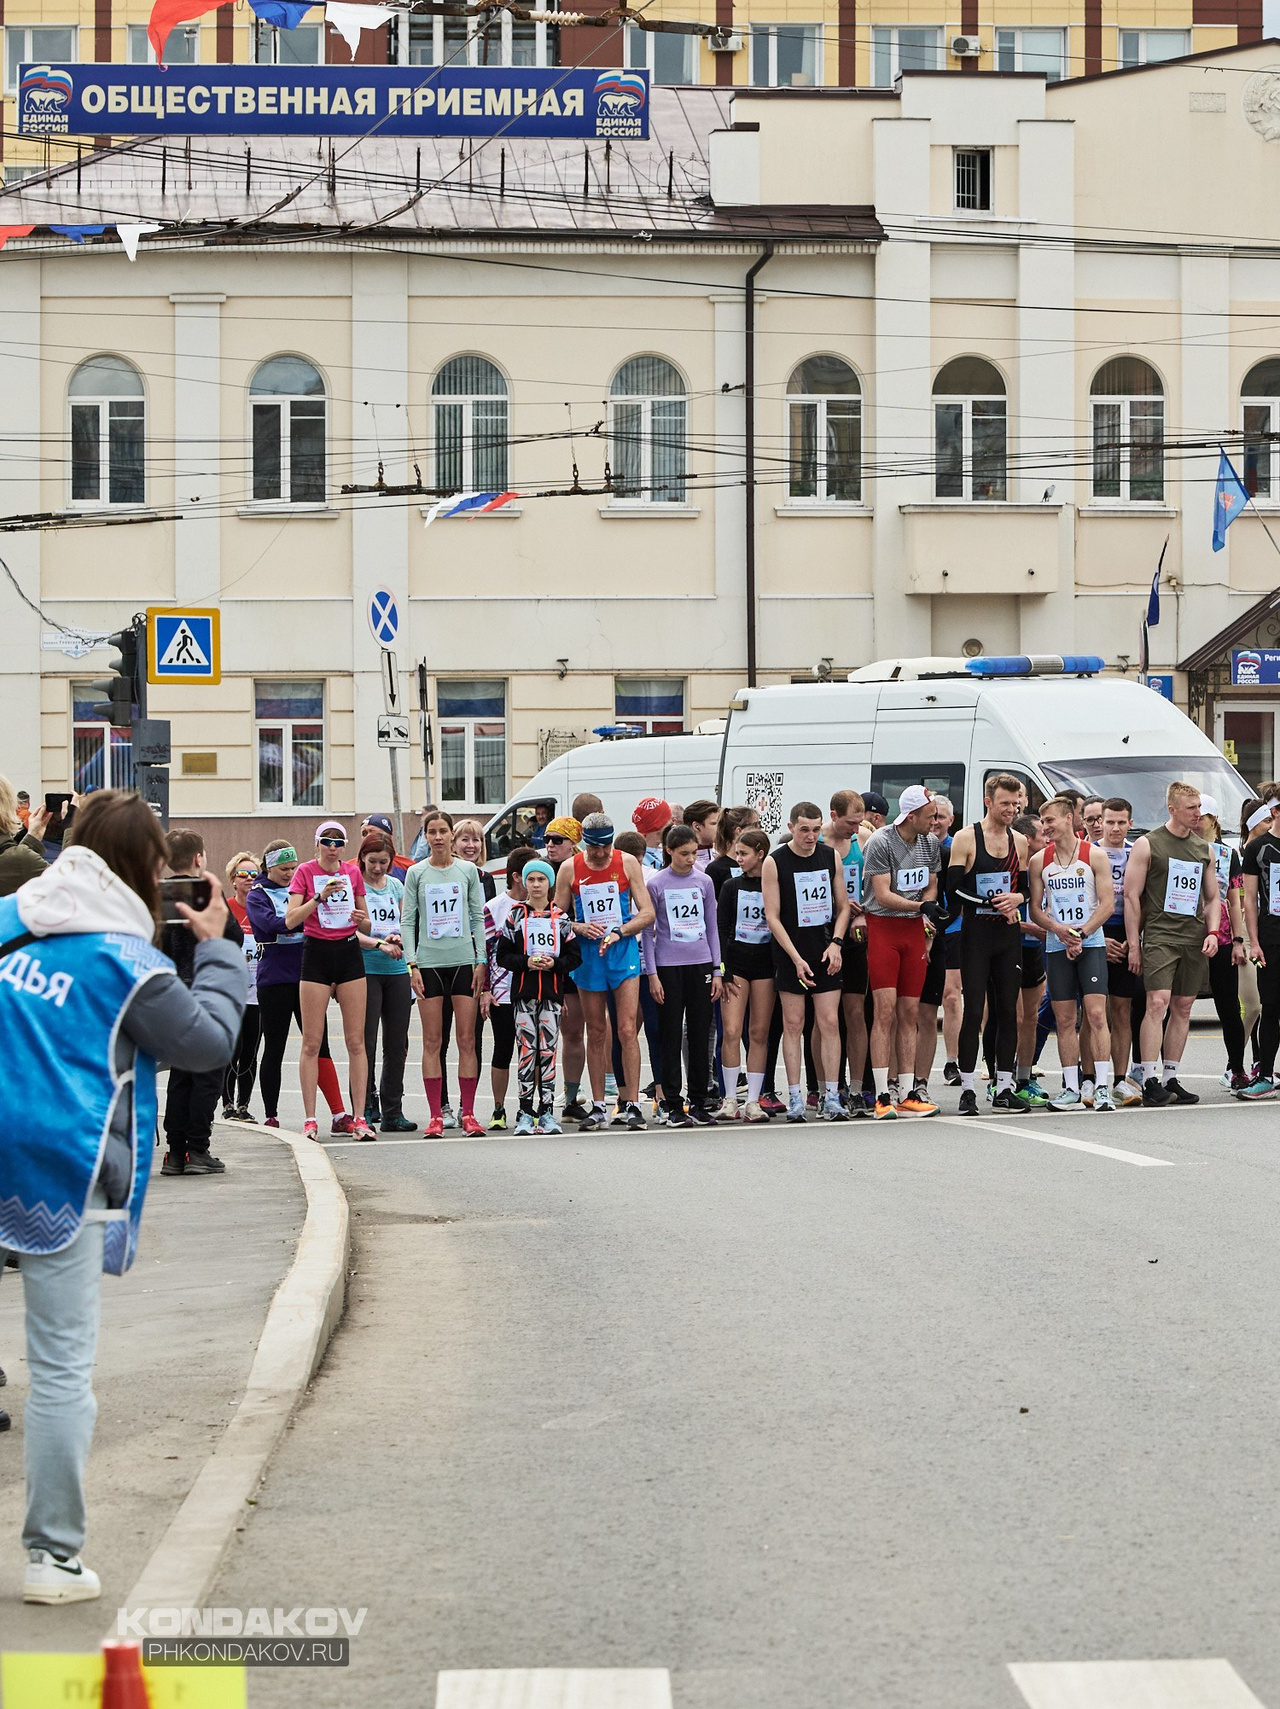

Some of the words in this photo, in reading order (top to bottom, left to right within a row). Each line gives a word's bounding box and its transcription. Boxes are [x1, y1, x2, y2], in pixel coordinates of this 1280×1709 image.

[81, 84, 376, 118] ОБЩЕСТВЕННАЯ
[387, 87, 584, 117] ПРИЕМНАЯ
[23, 114, 68, 123] ЕДИНАЯ
[596, 118, 641, 127] ЕДИНАЯ
[23, 124, 68, 132] РОССИЯ
[596, 128, 641, 136] РОССИЯ
[904, 870, 923, 885] 116
[1047, 877, 1085, 890] RUSSIA
[1173, 875, 1197, 890] 198
[802, 886, 827, 901] 142
[432, 899, 457, 913] 117
[588, 898, 614, 913] 187
[672, 904, 699, 918] 124
[371, 909, 396, 921] 194
[1059, 907, 1083, 921] 118
[529, 933, 554, 946] 186
[0, 951, 74, 1008] ДЬЯ
